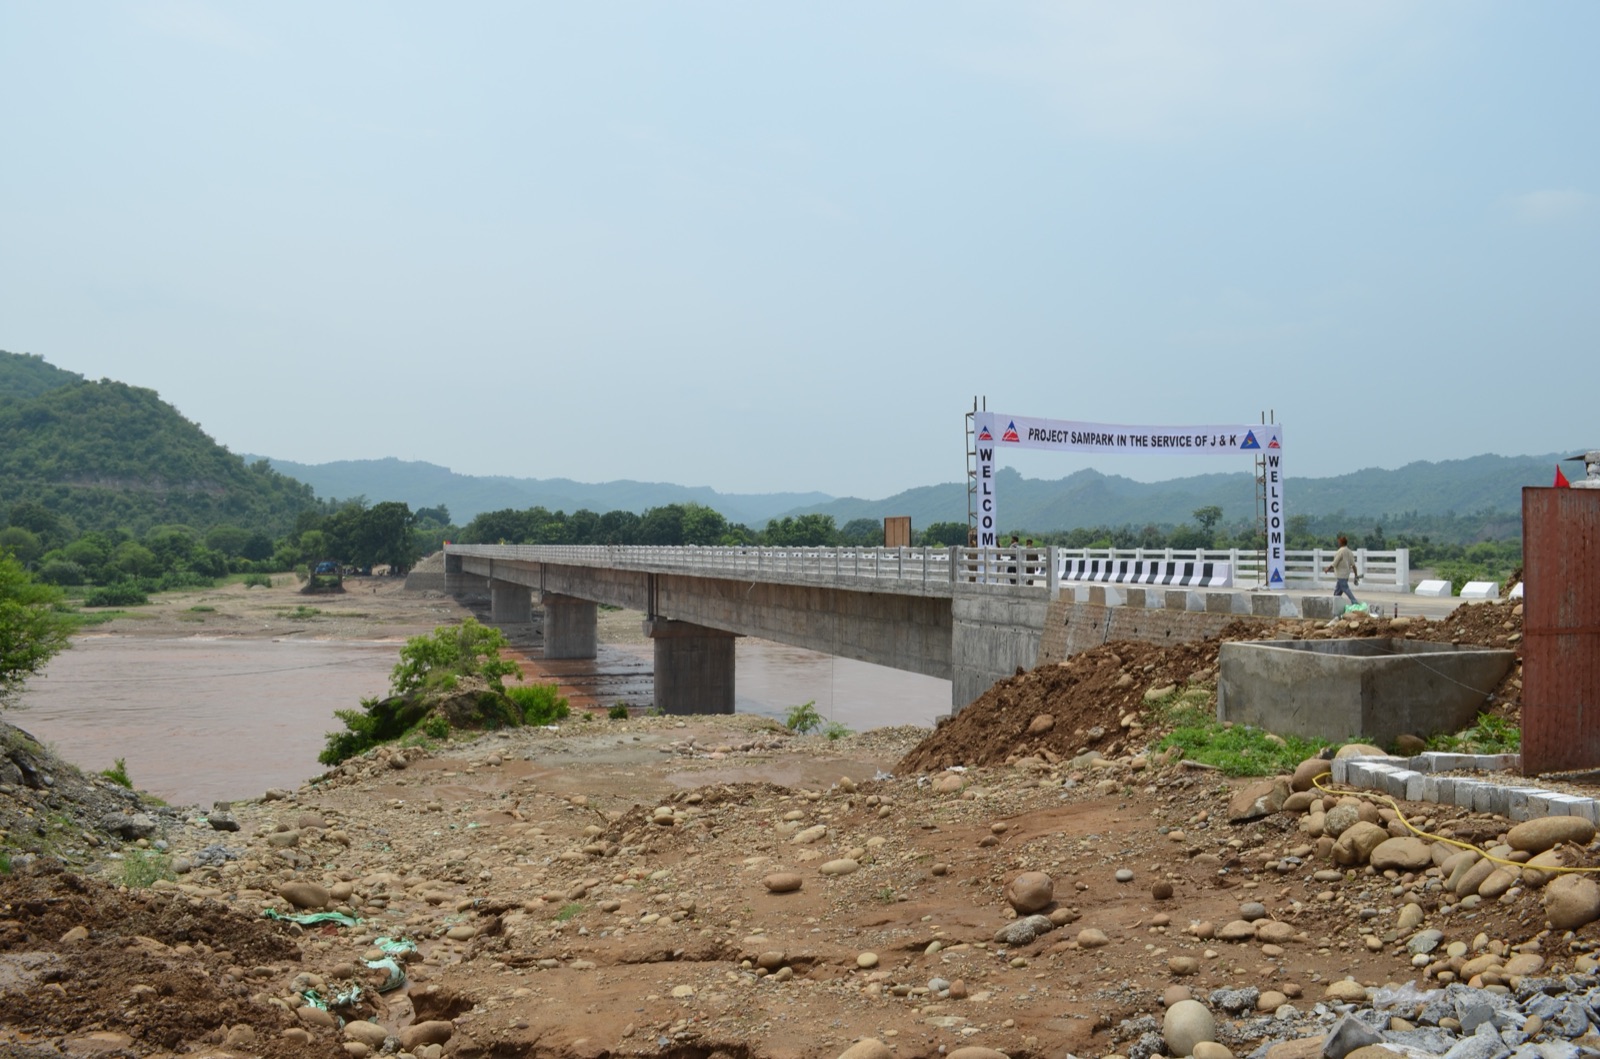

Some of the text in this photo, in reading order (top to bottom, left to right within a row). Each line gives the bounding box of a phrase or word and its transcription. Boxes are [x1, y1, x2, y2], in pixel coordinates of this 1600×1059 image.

[1028, 428, 1237, 447] PROJECT SAMPARK IN THE SERVICE OF J & K
[1268, 455, 1281, 559] WELCOME
